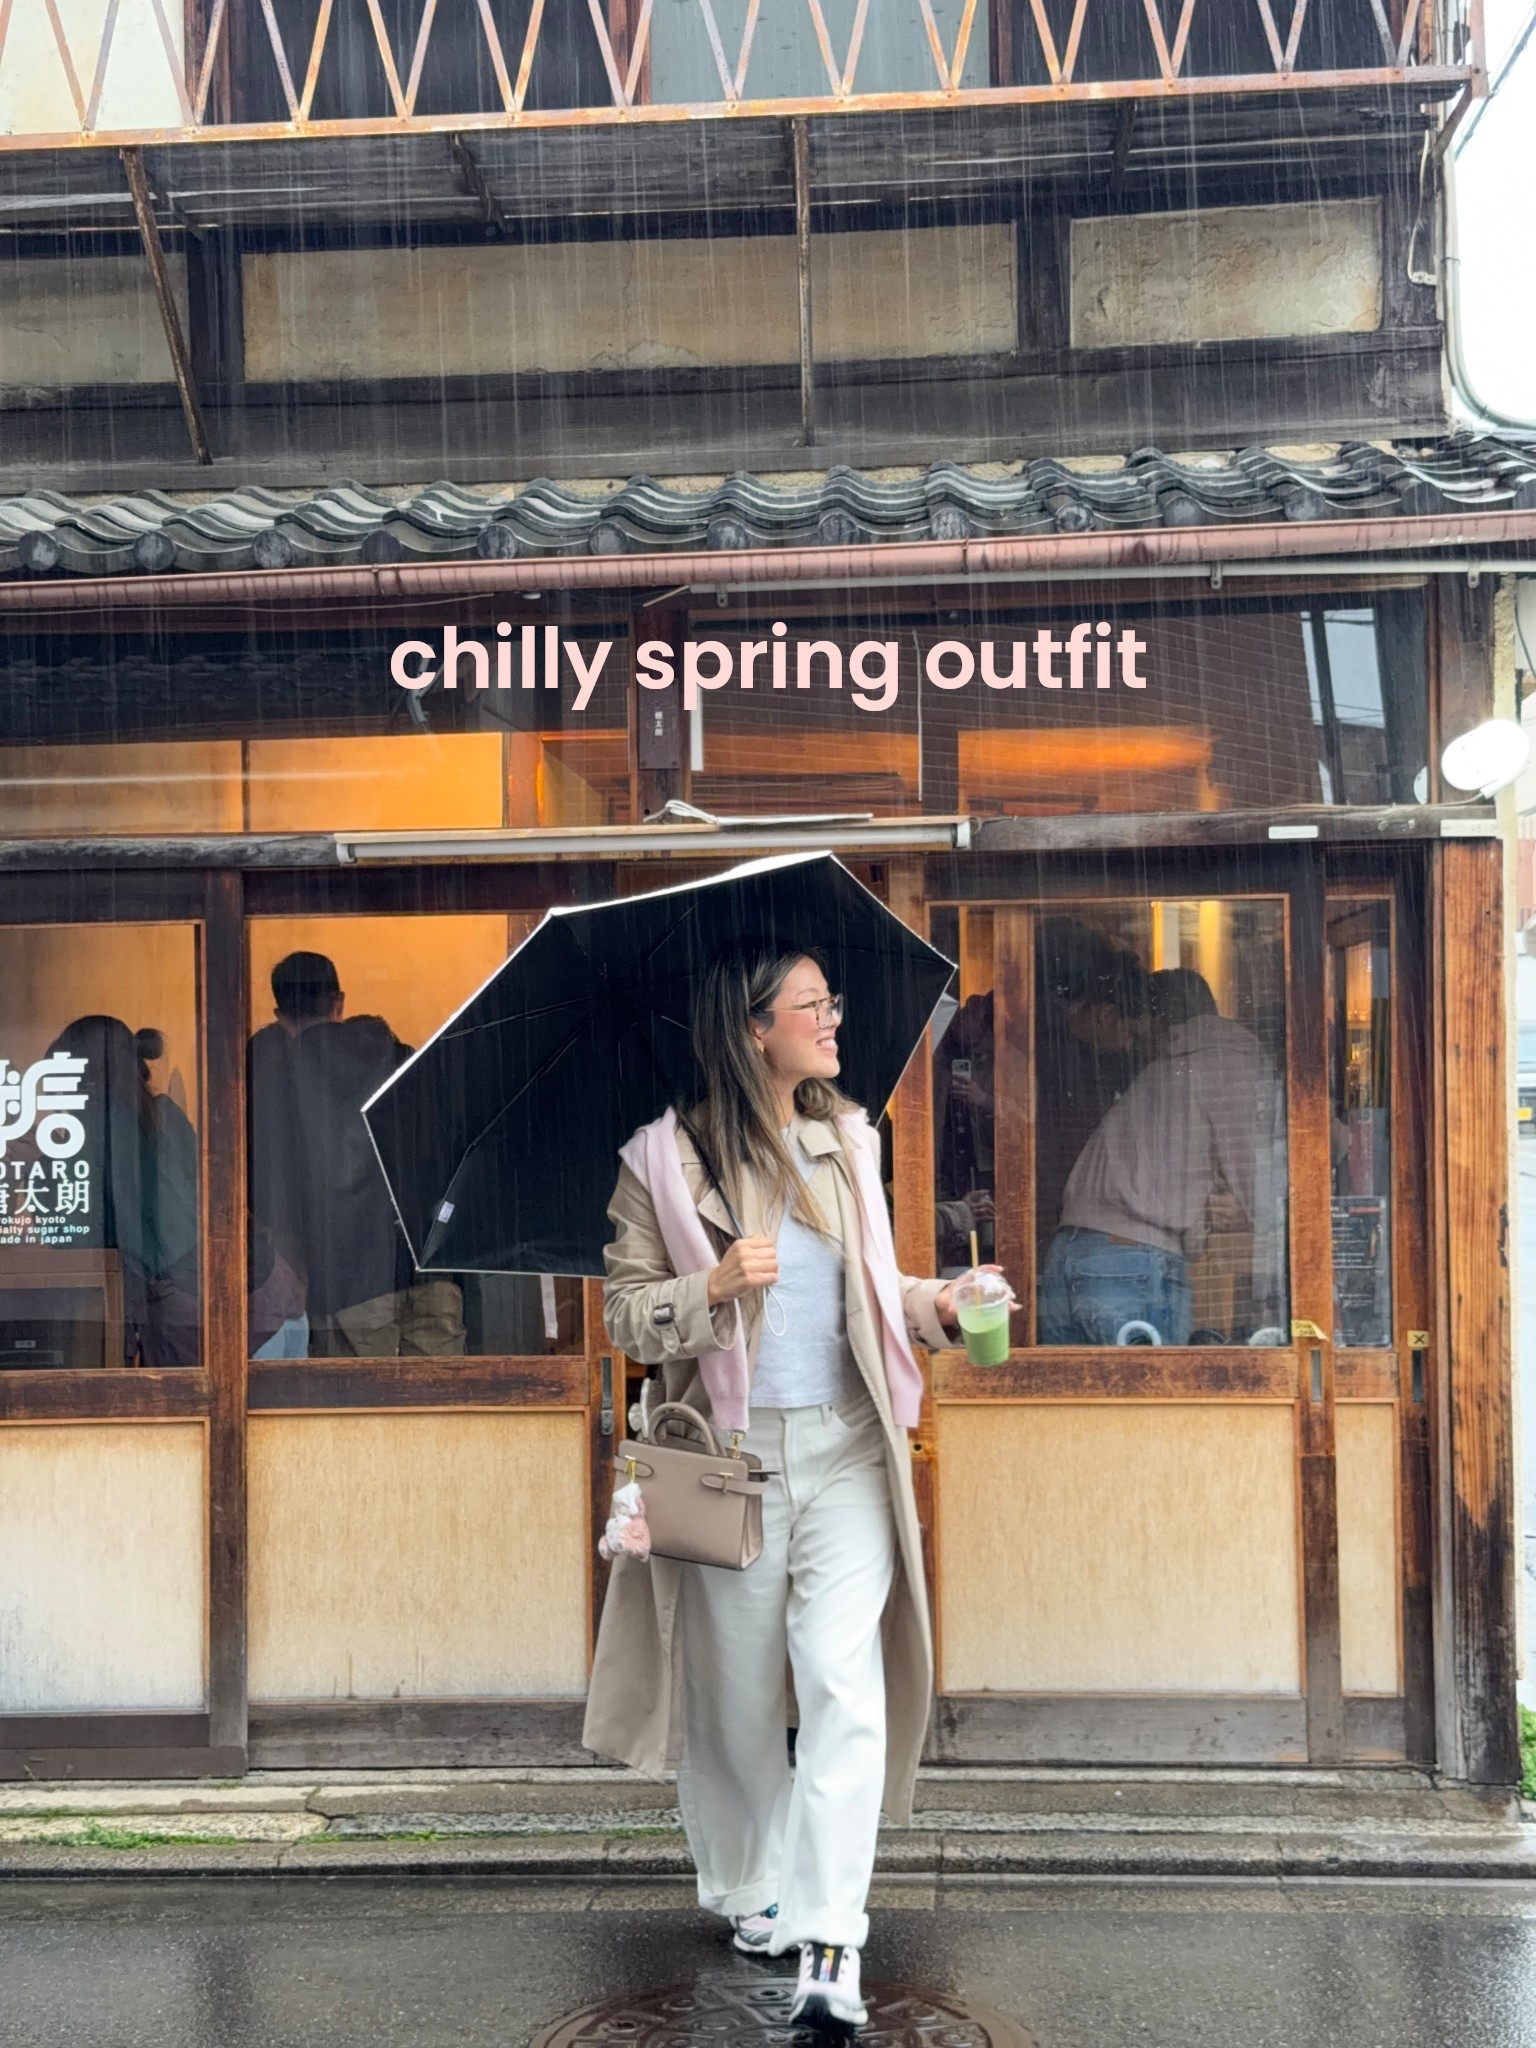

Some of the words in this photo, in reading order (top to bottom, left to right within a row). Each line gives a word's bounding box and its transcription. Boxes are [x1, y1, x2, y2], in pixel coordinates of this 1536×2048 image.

[0, 1179, 90, 1215] 太朗
[0, 1216, 32, 1226] okujo
[35, 1215, 66, 1225] kyoto
[27, 1226, 59, 1236] sugar
[63, 1225, 90, 1235] shop
[25, 1235, 36, 1244] in
[41, 1235, 72, 1246] japan
